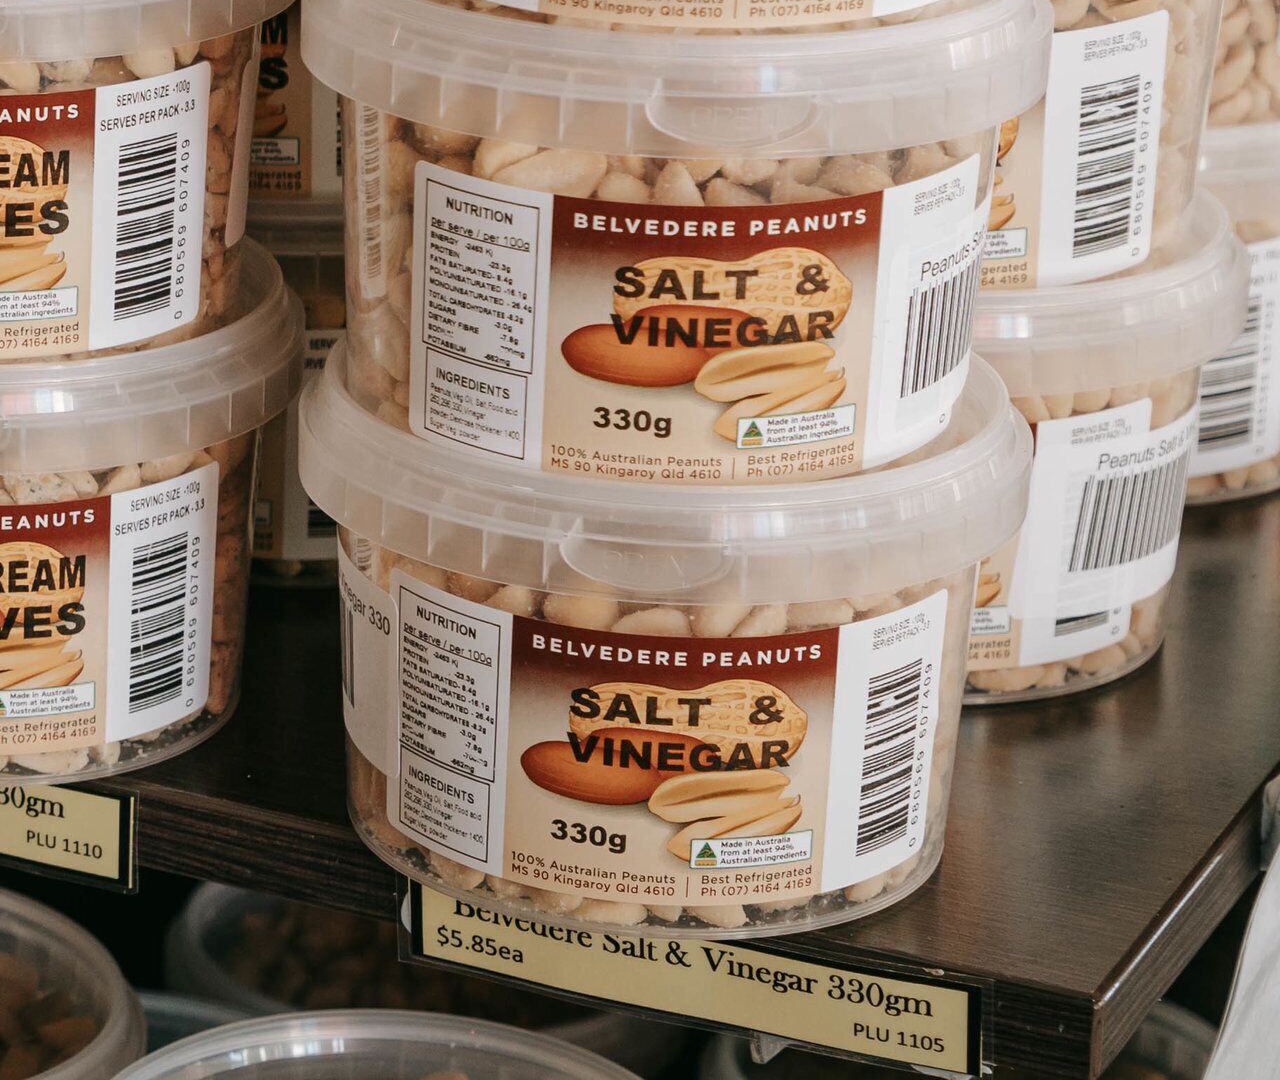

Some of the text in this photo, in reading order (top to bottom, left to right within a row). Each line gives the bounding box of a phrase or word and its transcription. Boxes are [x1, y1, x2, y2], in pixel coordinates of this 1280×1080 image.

[574, 209, 867, 237] BELVEDERE PEANUTS
[921, 244, 969, 281] Peanuts
[613, 264, 831, 301] SALT &
[609, 310, 834, 348] VINEGAR
[593, 407, 671, 438] 330g
[1098, 447, 1155, 470] Peanuts
[369, 605, 390, 635] 330
[416, 605, 477, 639] NUTRITION
[533, 634, 822, 667] BELVEDERE PEANUTS
[570, 688, 784, 727] SALT &
[566, 732, 791, 772] VINEGAR
[27, 830, 102, 859] PLU 1110
[551, 819, 627, 854] 330g
[437, 925, 524, 963] $5.85ea
[603, 934, 658, 962] Salt
[665, 940, 691, 967] &
[700, 947, 818, 994] Vinegar
[828, 975, 934, 1019] 330gm
[853, 1023, 945, 1053] PLU 1105
